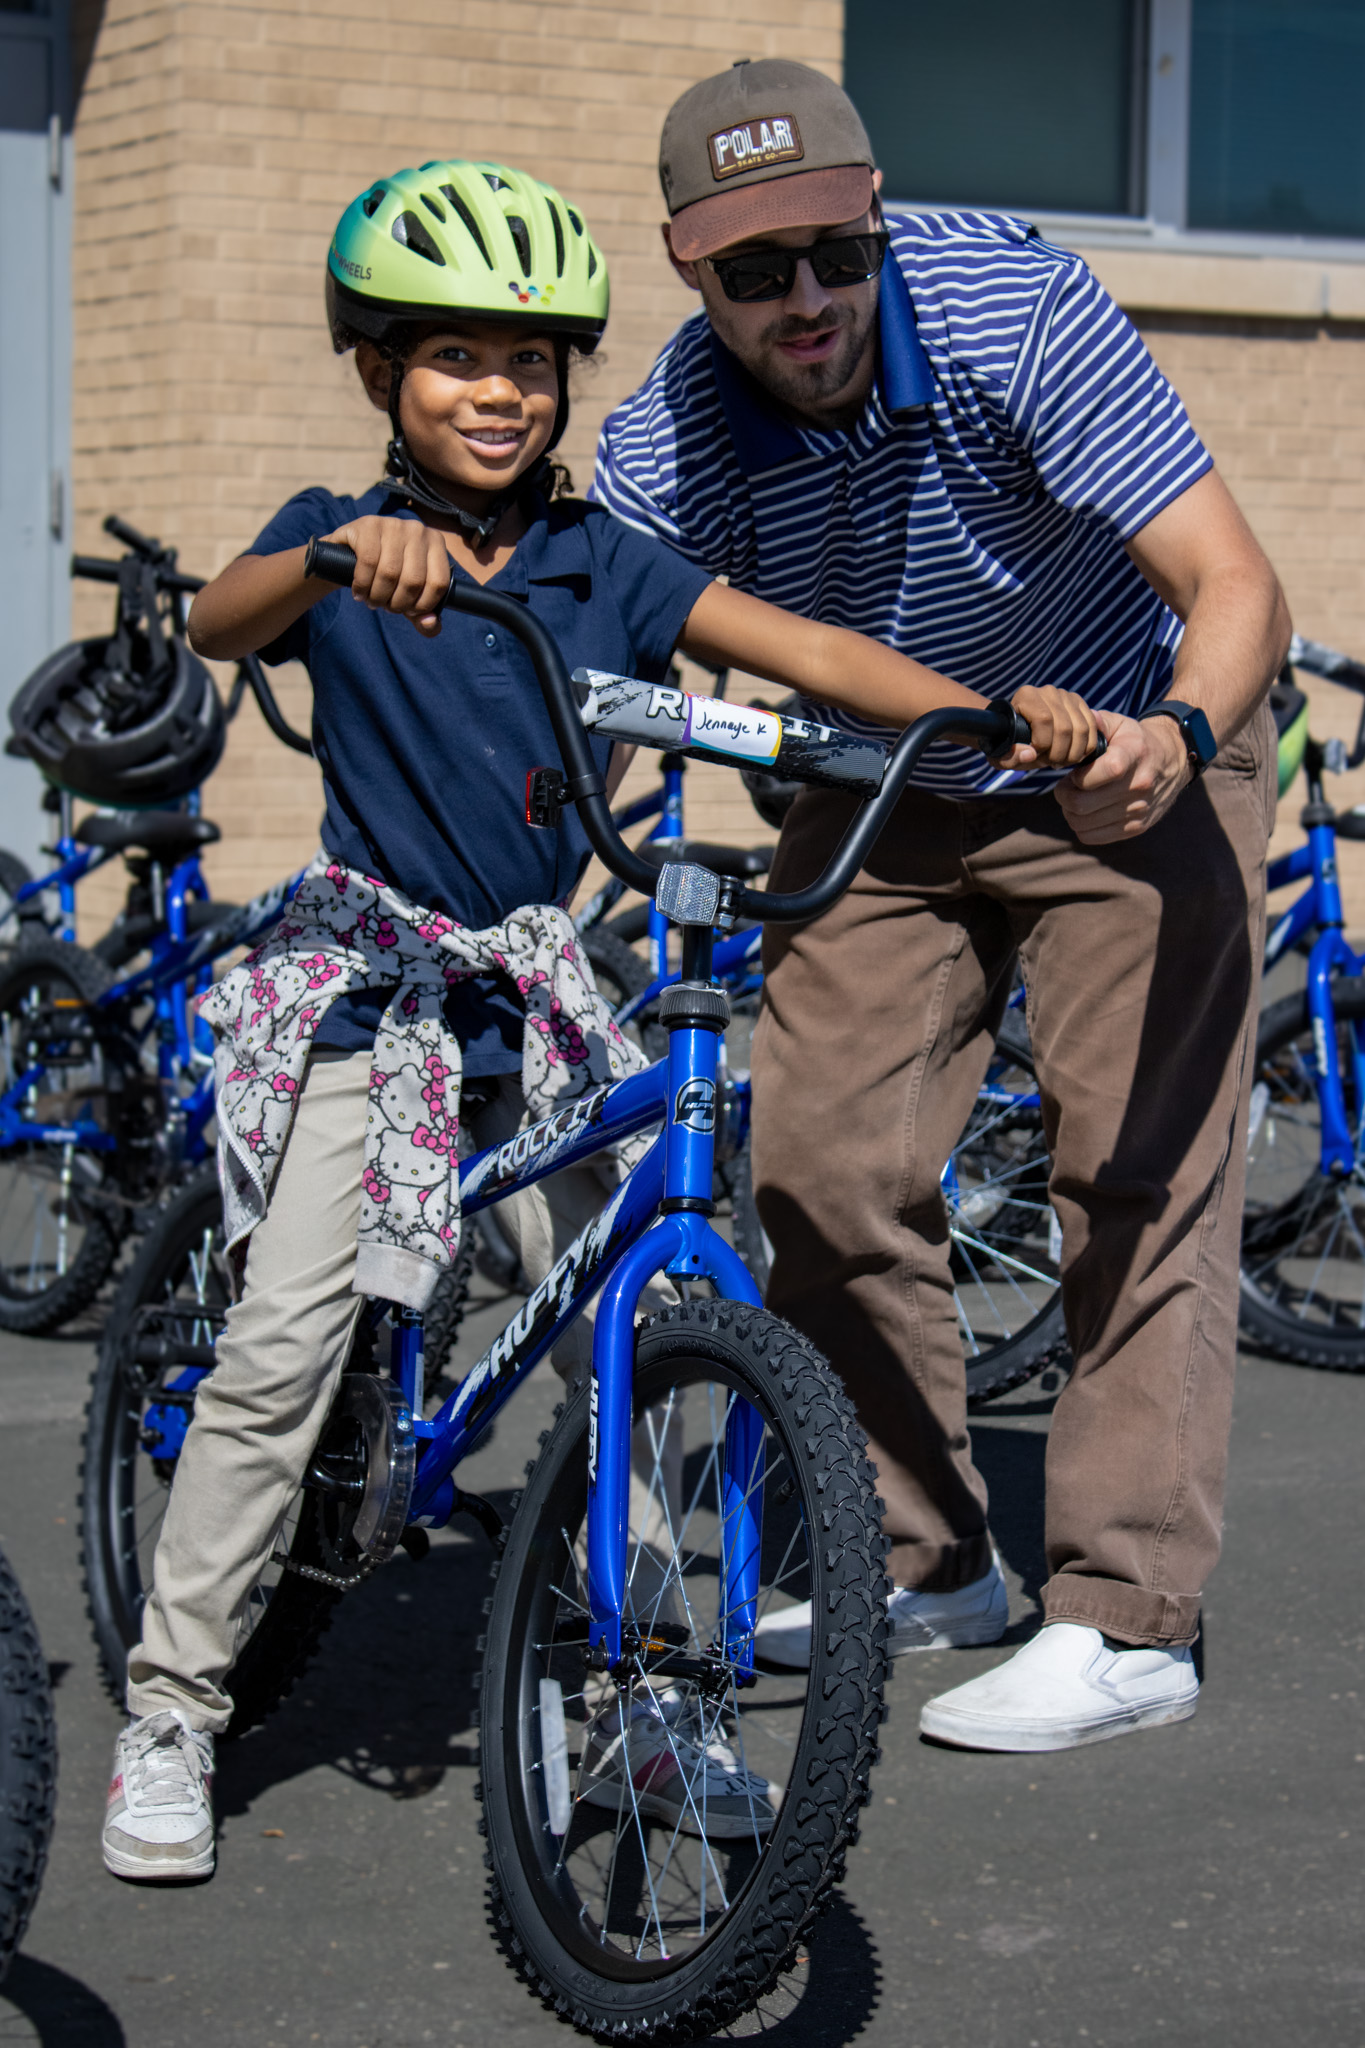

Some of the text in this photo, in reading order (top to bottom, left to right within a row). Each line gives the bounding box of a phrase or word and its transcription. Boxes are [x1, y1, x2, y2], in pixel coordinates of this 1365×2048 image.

[737, 152, 779, 167] SKATE CO.
[338, 253, 373, 280] WHEELS
[498, 1110, 566, 1179] ROCK
[490, 1217, 595, 1379] HUFFY
